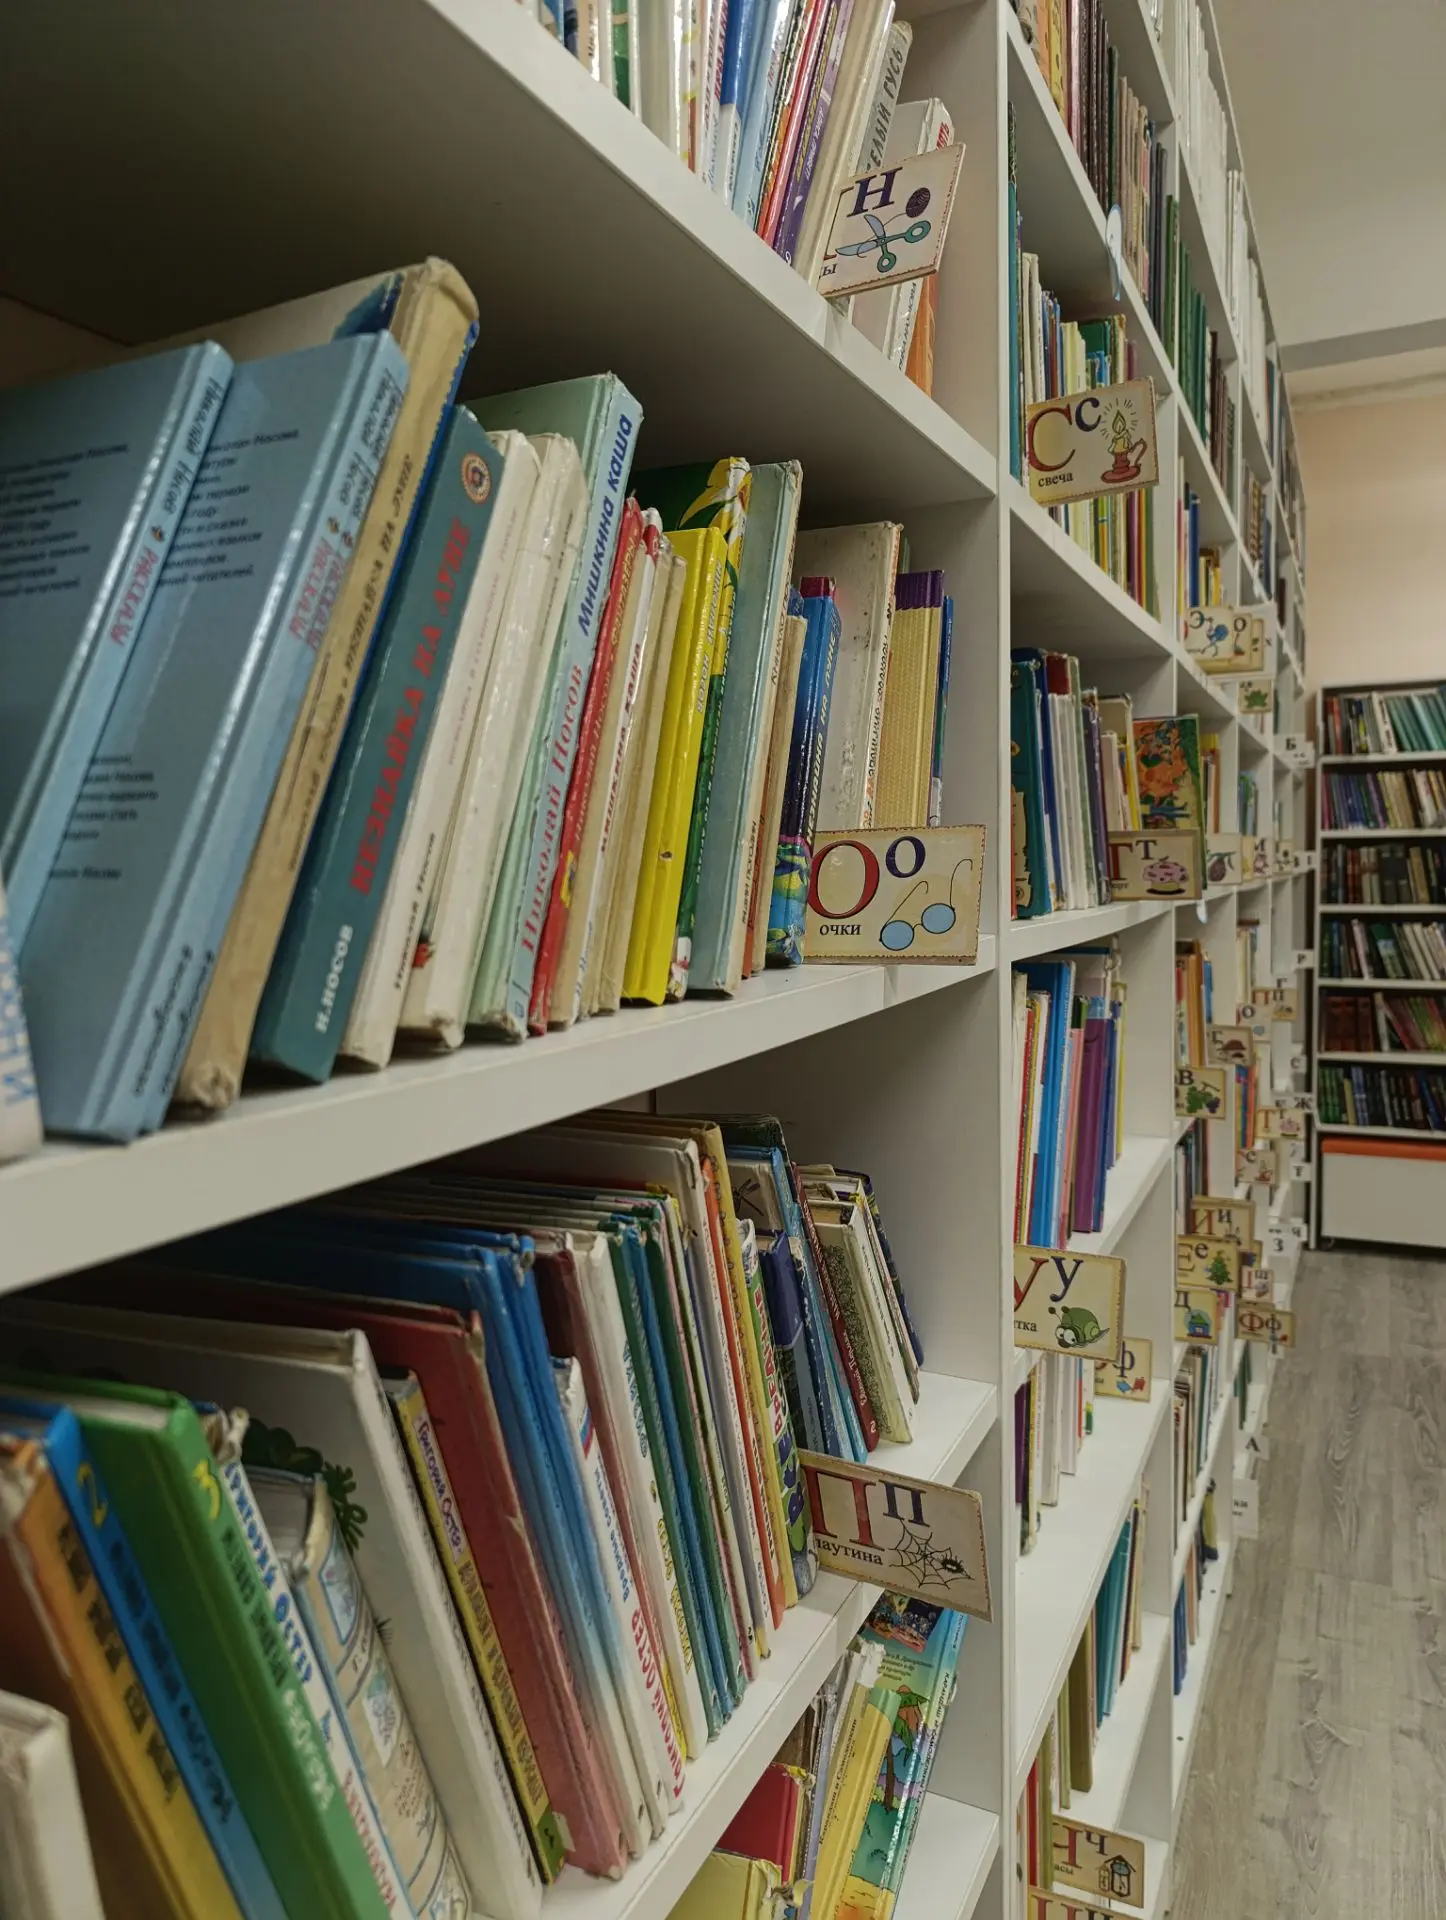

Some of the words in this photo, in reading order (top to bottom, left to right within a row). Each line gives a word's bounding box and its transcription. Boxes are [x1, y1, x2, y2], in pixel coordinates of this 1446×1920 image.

[881, 47, 904, 99] ГУСЬ
[182, 377, 225, 458] Николай
[159, 459, 194, 516] Носов
[333, 451, 367, 506] Носов
[1038, 473, 1074, 488] свеча
[573, 494, 616, 637] Мишкина
[605, 413, 634, 492] каша
[106, 545, 162, 648] РАССКАЗЫ
[347, 683, 425, 895] НЕЗНАЙКА
[410, 623, 443, 677] НА
[428, 515, 474, 615] ЛУНЕ
[693, 652, 711, 713] НОСОВ
[816, 695, 830, 724] НА
[518, 782, 562, 954] Николай
[549, 663, 586, 773] Носов
[819, 924, 861, 936] очки
[412, 1420, 450, 1500] Григорий
[627, 1607, 660, 1689] ОСТЕР
[818, 1791, 837, 1844] Карандаш
[836, 1718, 857, 1780] Самоделкин
